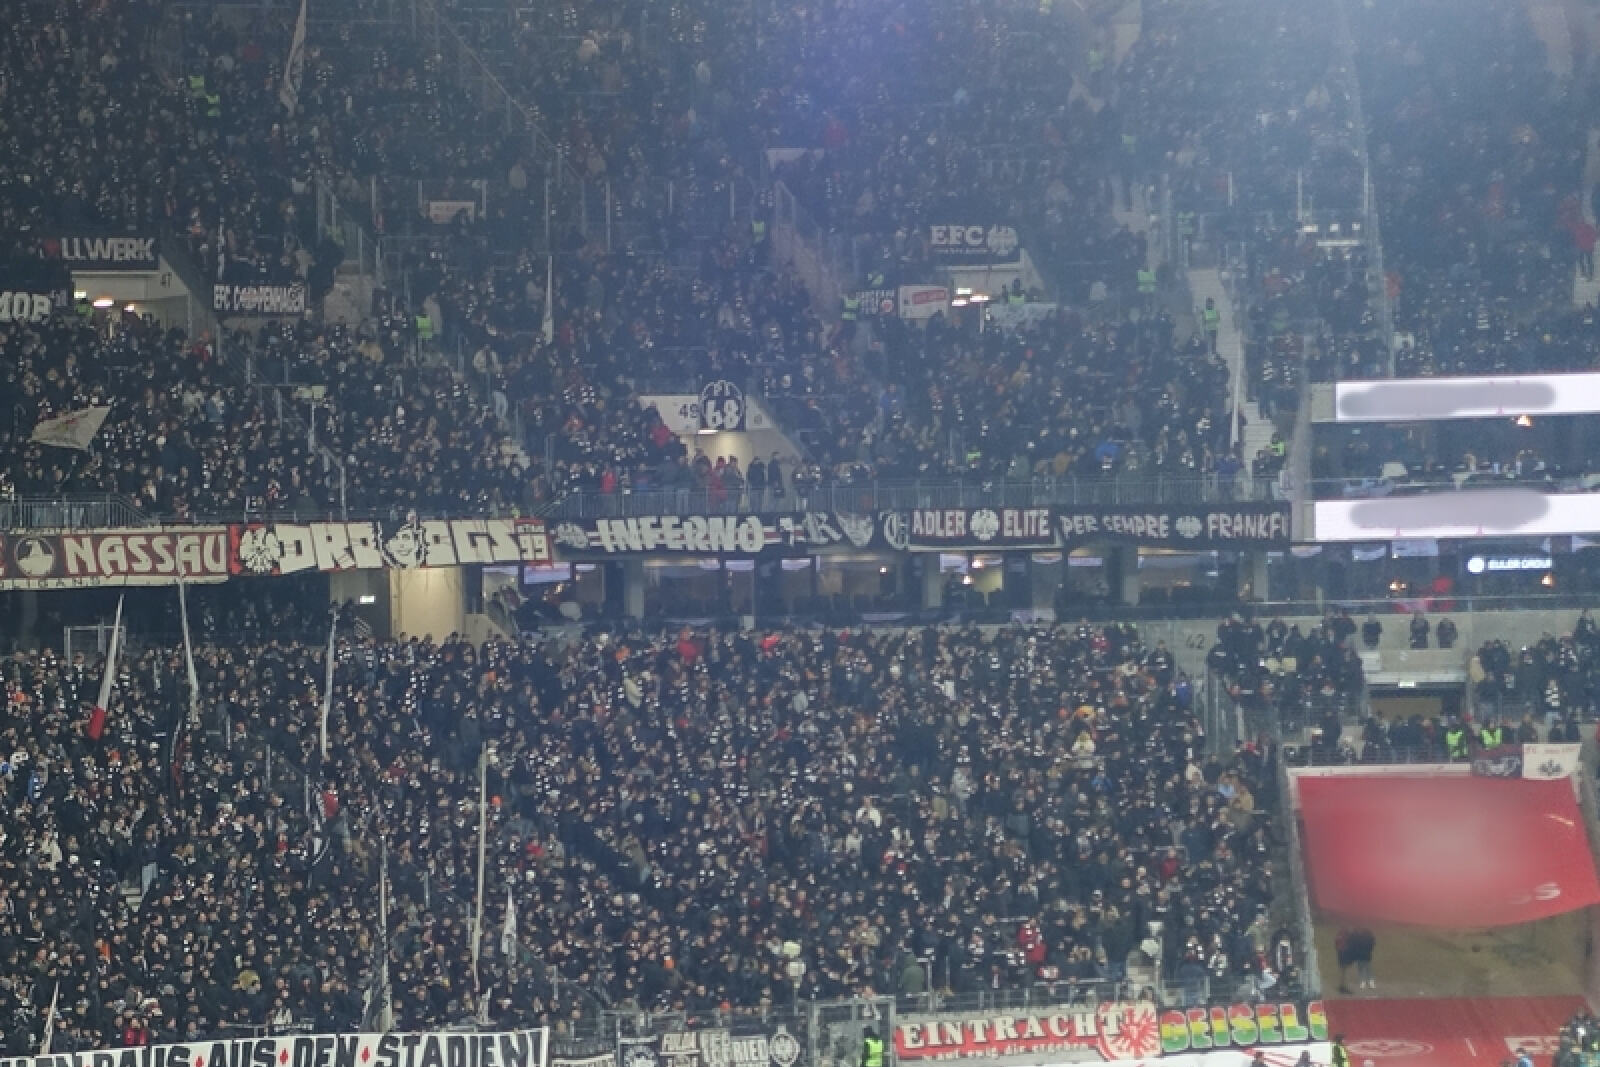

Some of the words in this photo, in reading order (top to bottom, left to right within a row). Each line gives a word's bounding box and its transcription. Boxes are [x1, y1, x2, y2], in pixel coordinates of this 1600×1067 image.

[931, 225, 984, 245] EFC
[596, 515, 765, 553] INFERNO
[911, 509, 967, 537] ADLER
[1003, 509, 1049, 537] ELITE
[64, 534, 226, 576] NASSAU
[902, 1010, 1125, 1049] EINTRACHT
